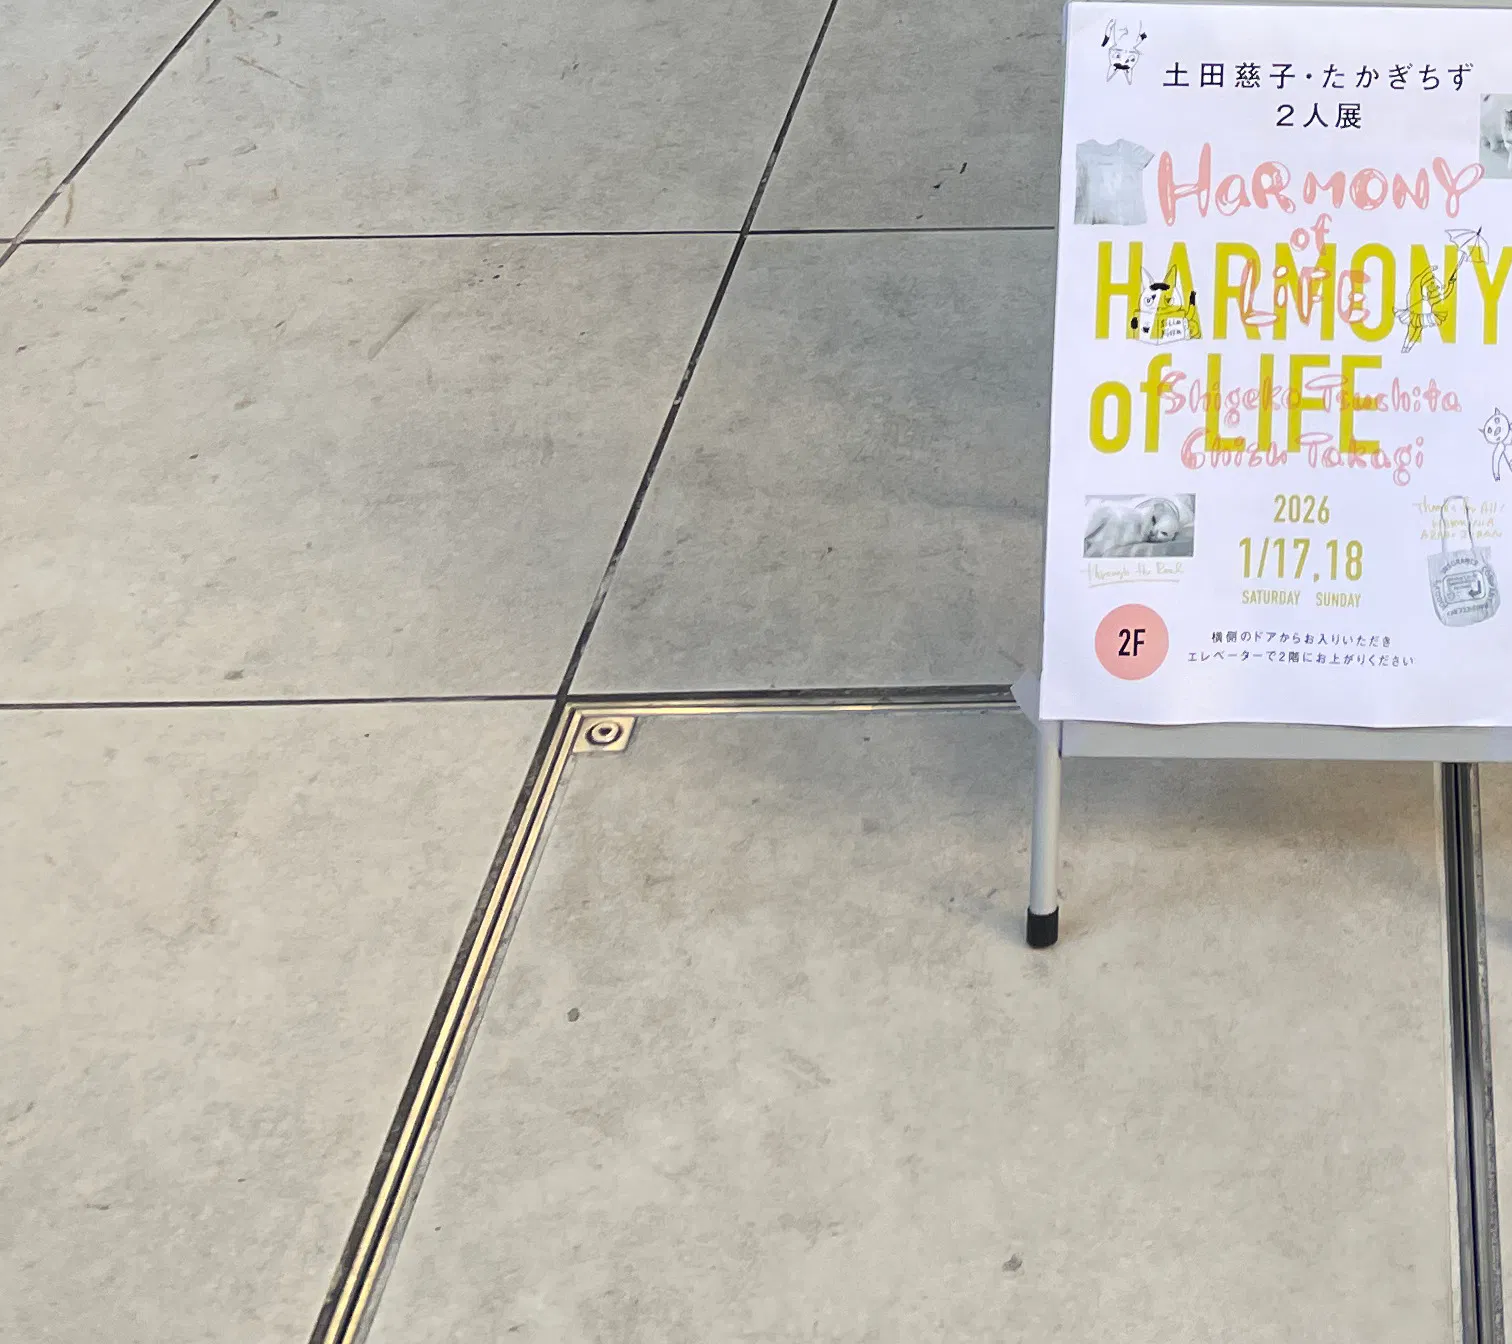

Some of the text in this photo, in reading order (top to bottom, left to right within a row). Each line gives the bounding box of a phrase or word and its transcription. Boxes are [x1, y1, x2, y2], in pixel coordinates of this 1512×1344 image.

[1162, 61, 1475, 91] 土田慈子・たかぎちず
[1275, 102, 1362, 130] 2人展
[1088, 352, 1383, 454] of LIFE
[1295, 431, 1424, 487] Takagi
[1273, 494, 1331, 525] 2026
[1241, 590, 1362, 608] SATURDAY SUNDAY
[1118, 629, 1147, 657] 2F
[1211, 630, 1392, 648] 横側のドアからお入りいただき
[1187, 650, 1416, 667] エレベーターで2階にお上がりください
